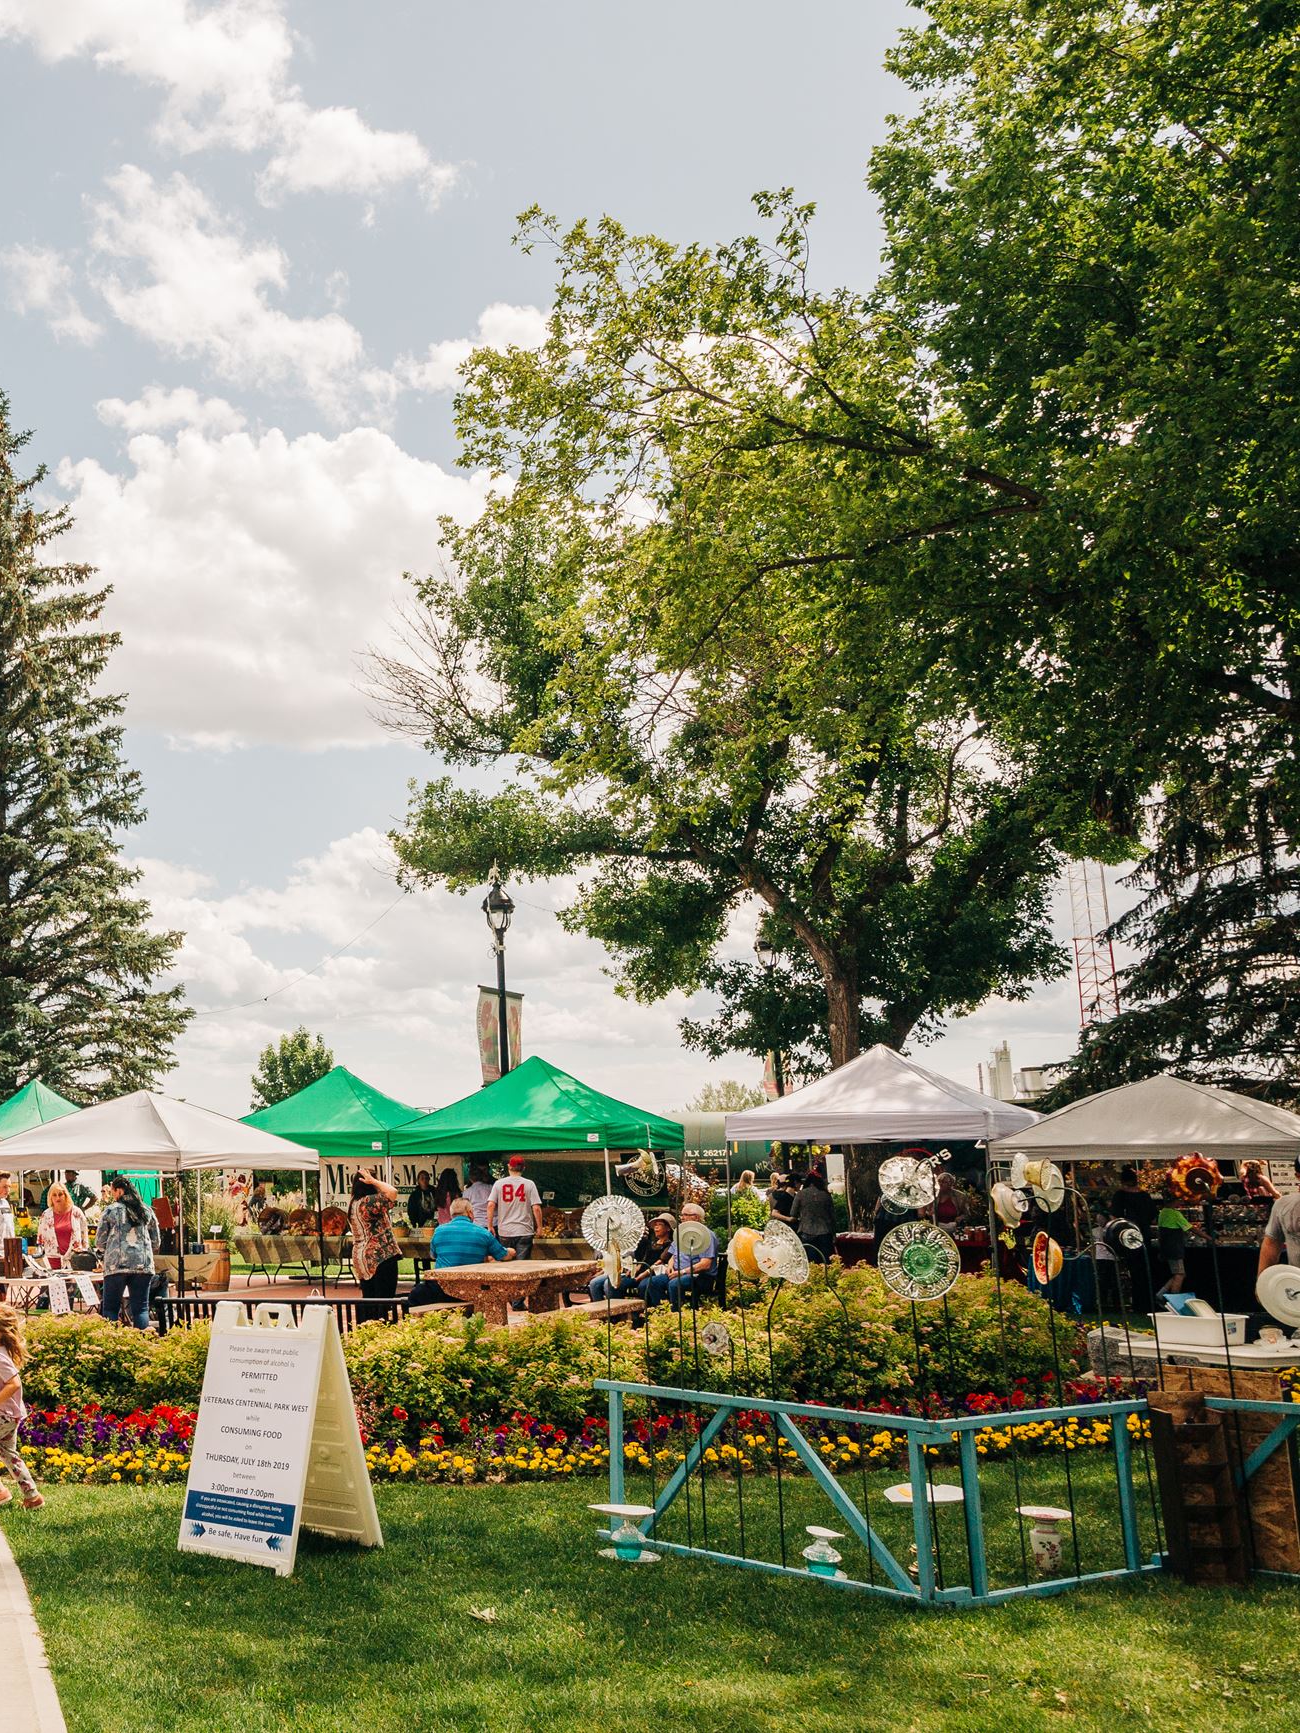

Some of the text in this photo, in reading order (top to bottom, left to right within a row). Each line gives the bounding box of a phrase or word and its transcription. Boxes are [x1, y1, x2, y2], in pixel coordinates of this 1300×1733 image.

[502, 1184, 526, 1202] 84
[229, 1344, 246, 1352] Please
[241, 1372, 278, 1381] PERMITTED
[204, 1396, 234, 1406] VETERANS
[235, 1399, 272, 1409] CENTENNIAL
[274, 1403, 290, 1411] PARK
[220, 1425, 282, 1439] CONSUMING FOOD
[206, 1452, 290, 1470] THURSDAY, JULY 18th 2019
[233, 1472, 256, 1480] between
[211, 1482, 234, 1493] 3:00pm
[250, 1489, 274, 1499] 7:00pm
[218, 1530, 232, 1539] safe,
[234, 1531, 250, 1541] Have
[252, 1535, 263, 1543] fun
